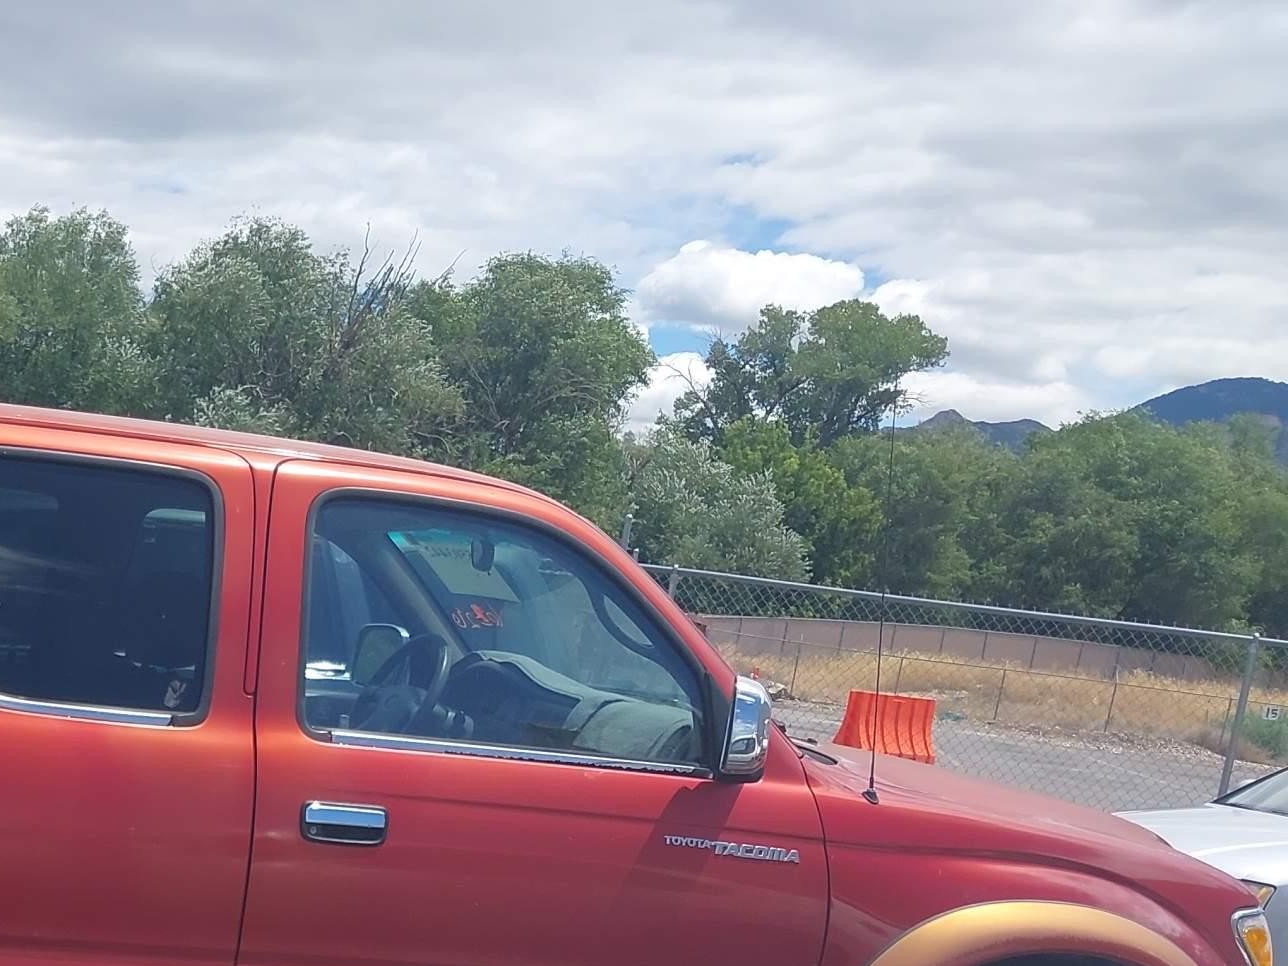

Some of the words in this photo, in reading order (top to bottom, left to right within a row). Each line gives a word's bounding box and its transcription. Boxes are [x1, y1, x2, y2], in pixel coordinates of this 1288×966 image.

[1265, 707, 1279, 719] 15
[664, 835, 712, 849] TOYOTA
[712, 841, 799, 864] TACOMA
